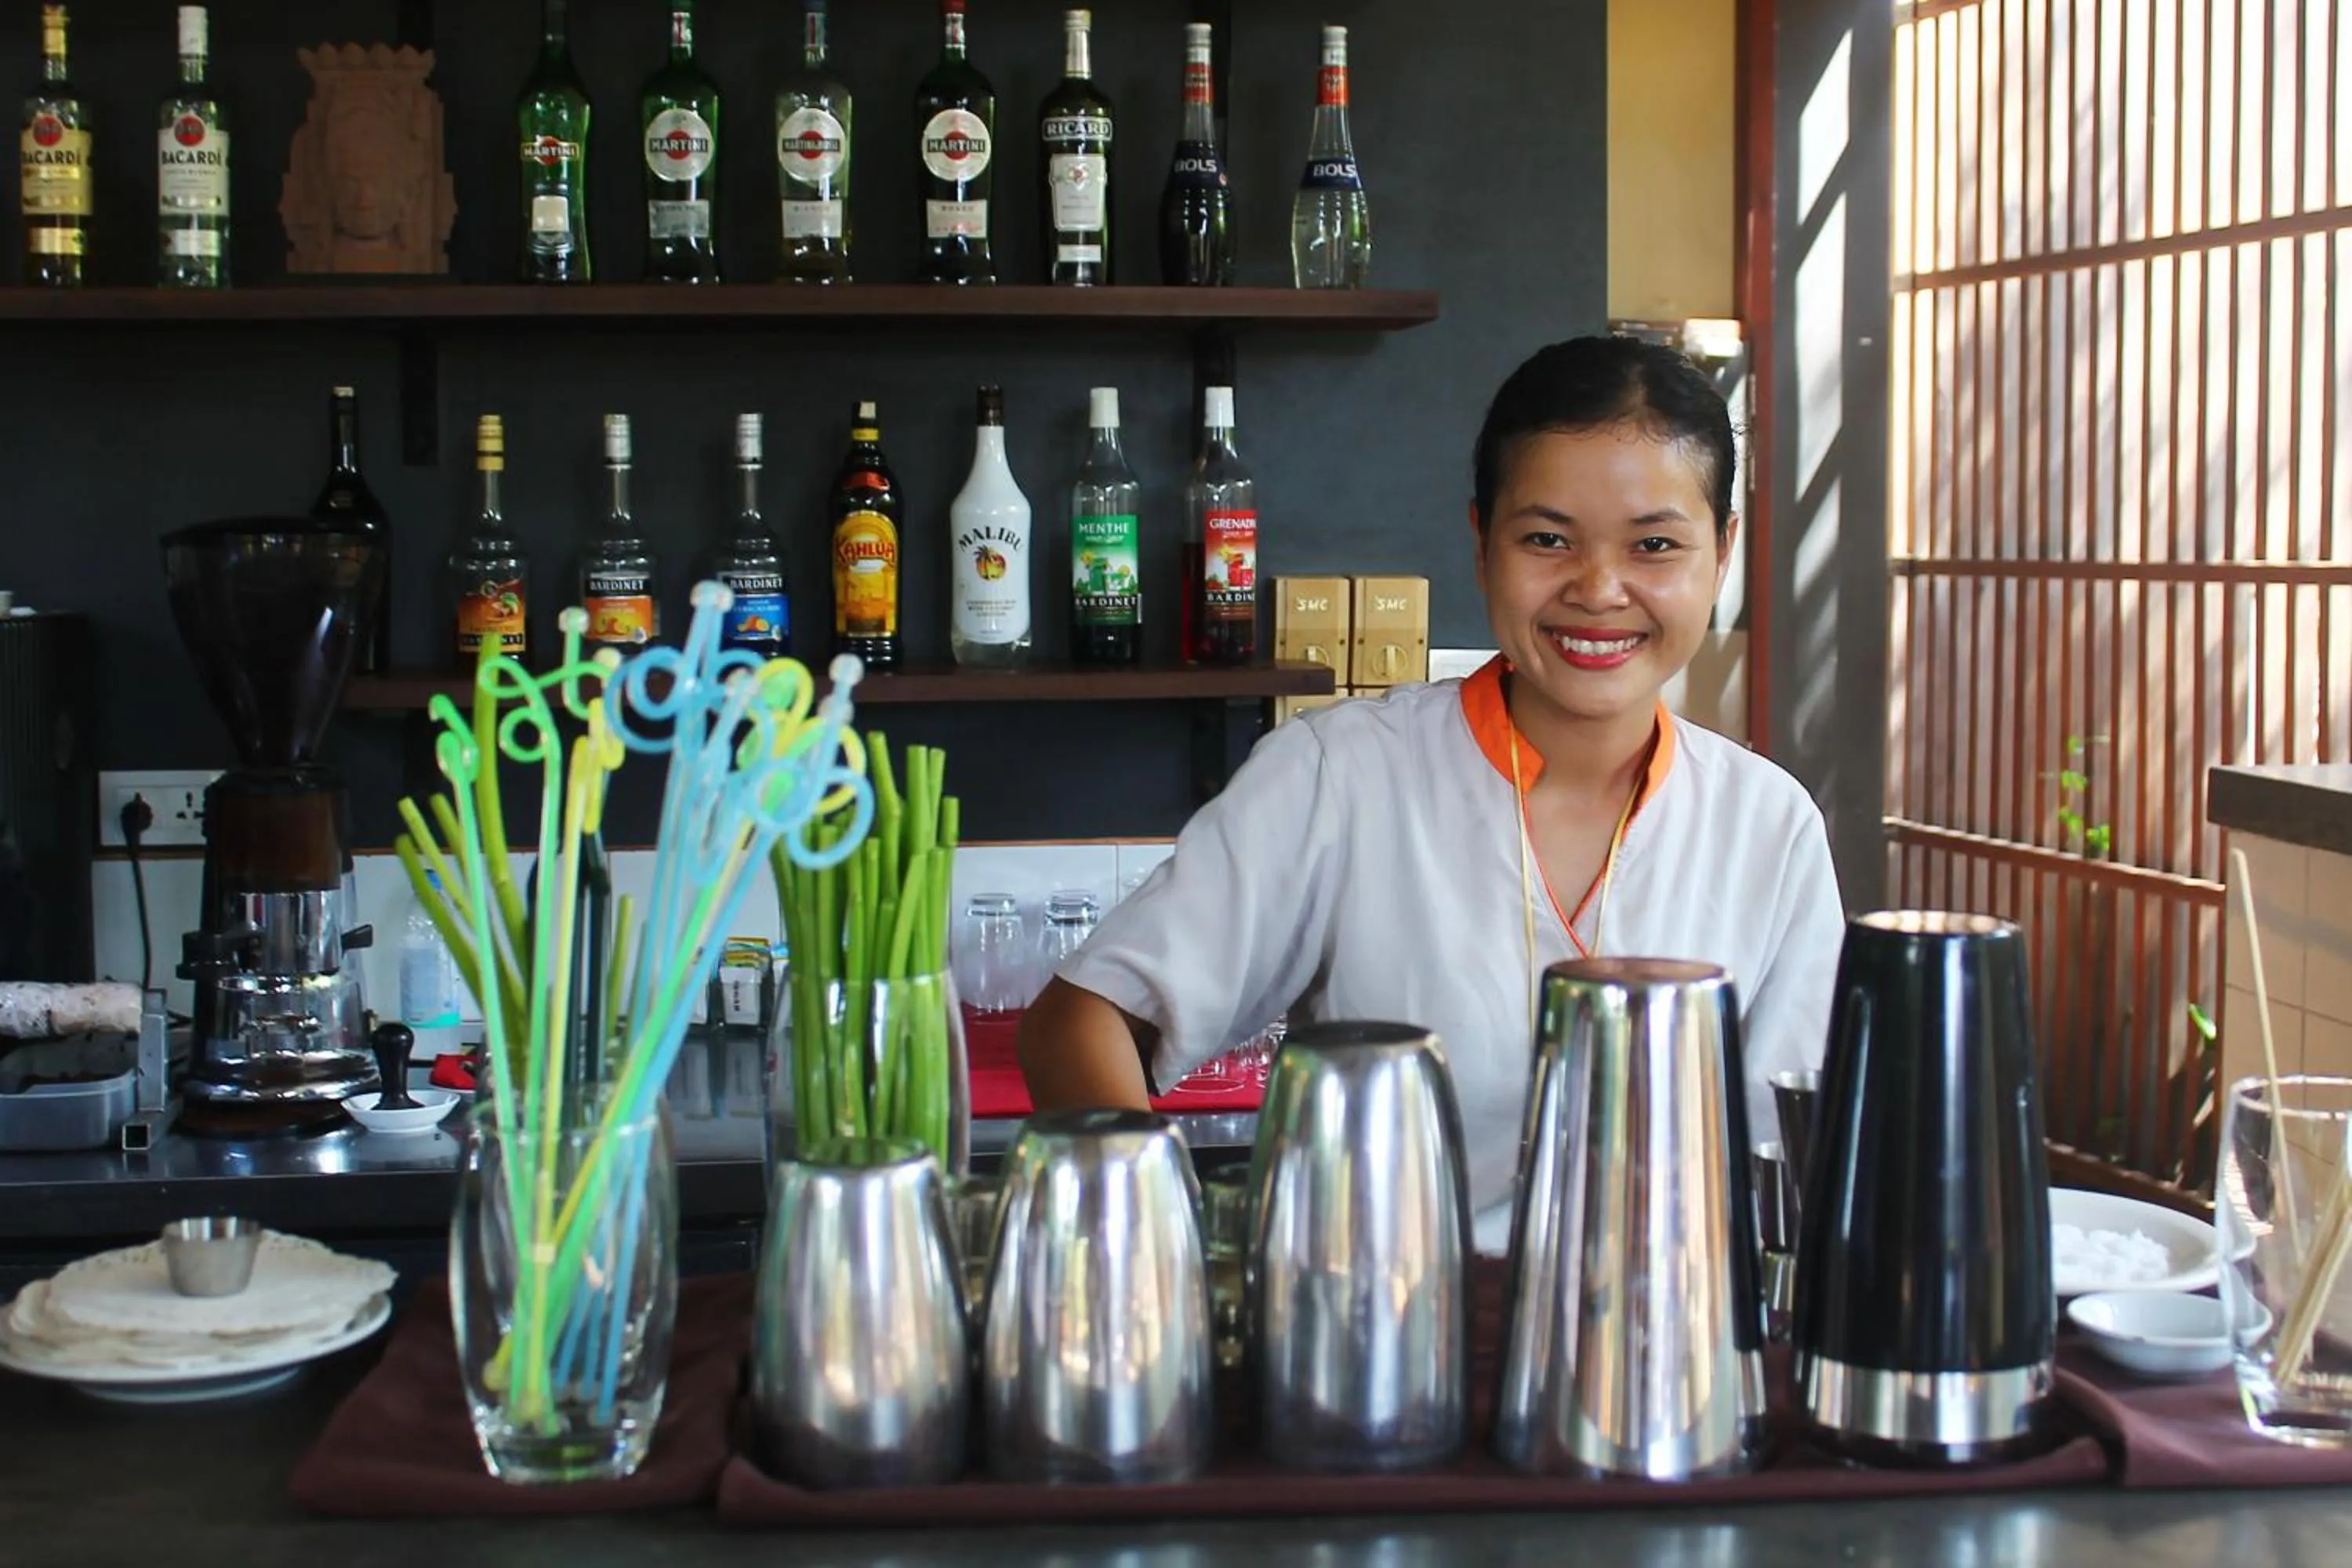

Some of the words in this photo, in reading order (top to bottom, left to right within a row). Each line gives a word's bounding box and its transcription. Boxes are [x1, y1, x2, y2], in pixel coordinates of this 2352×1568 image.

[1046, 121, 1110, 137] RICARD
[651, 137, 707, 152] MARTINI
[928, 139, 984, 152] MARTINI
[524, 147, 575, 157] MARTINI
[1176, 158, 1217, 173] BOLS
[1313, 163, 1356, 177] BOLS
[1078, 522, 1130, 534] MENTHE
[590, 579, 644, 590] BARDINET
[730, 577, 782, 590] BARDINET
[1296, 597, 1329, 612] SMC
[1376, 597, 1407, 611] SMC
